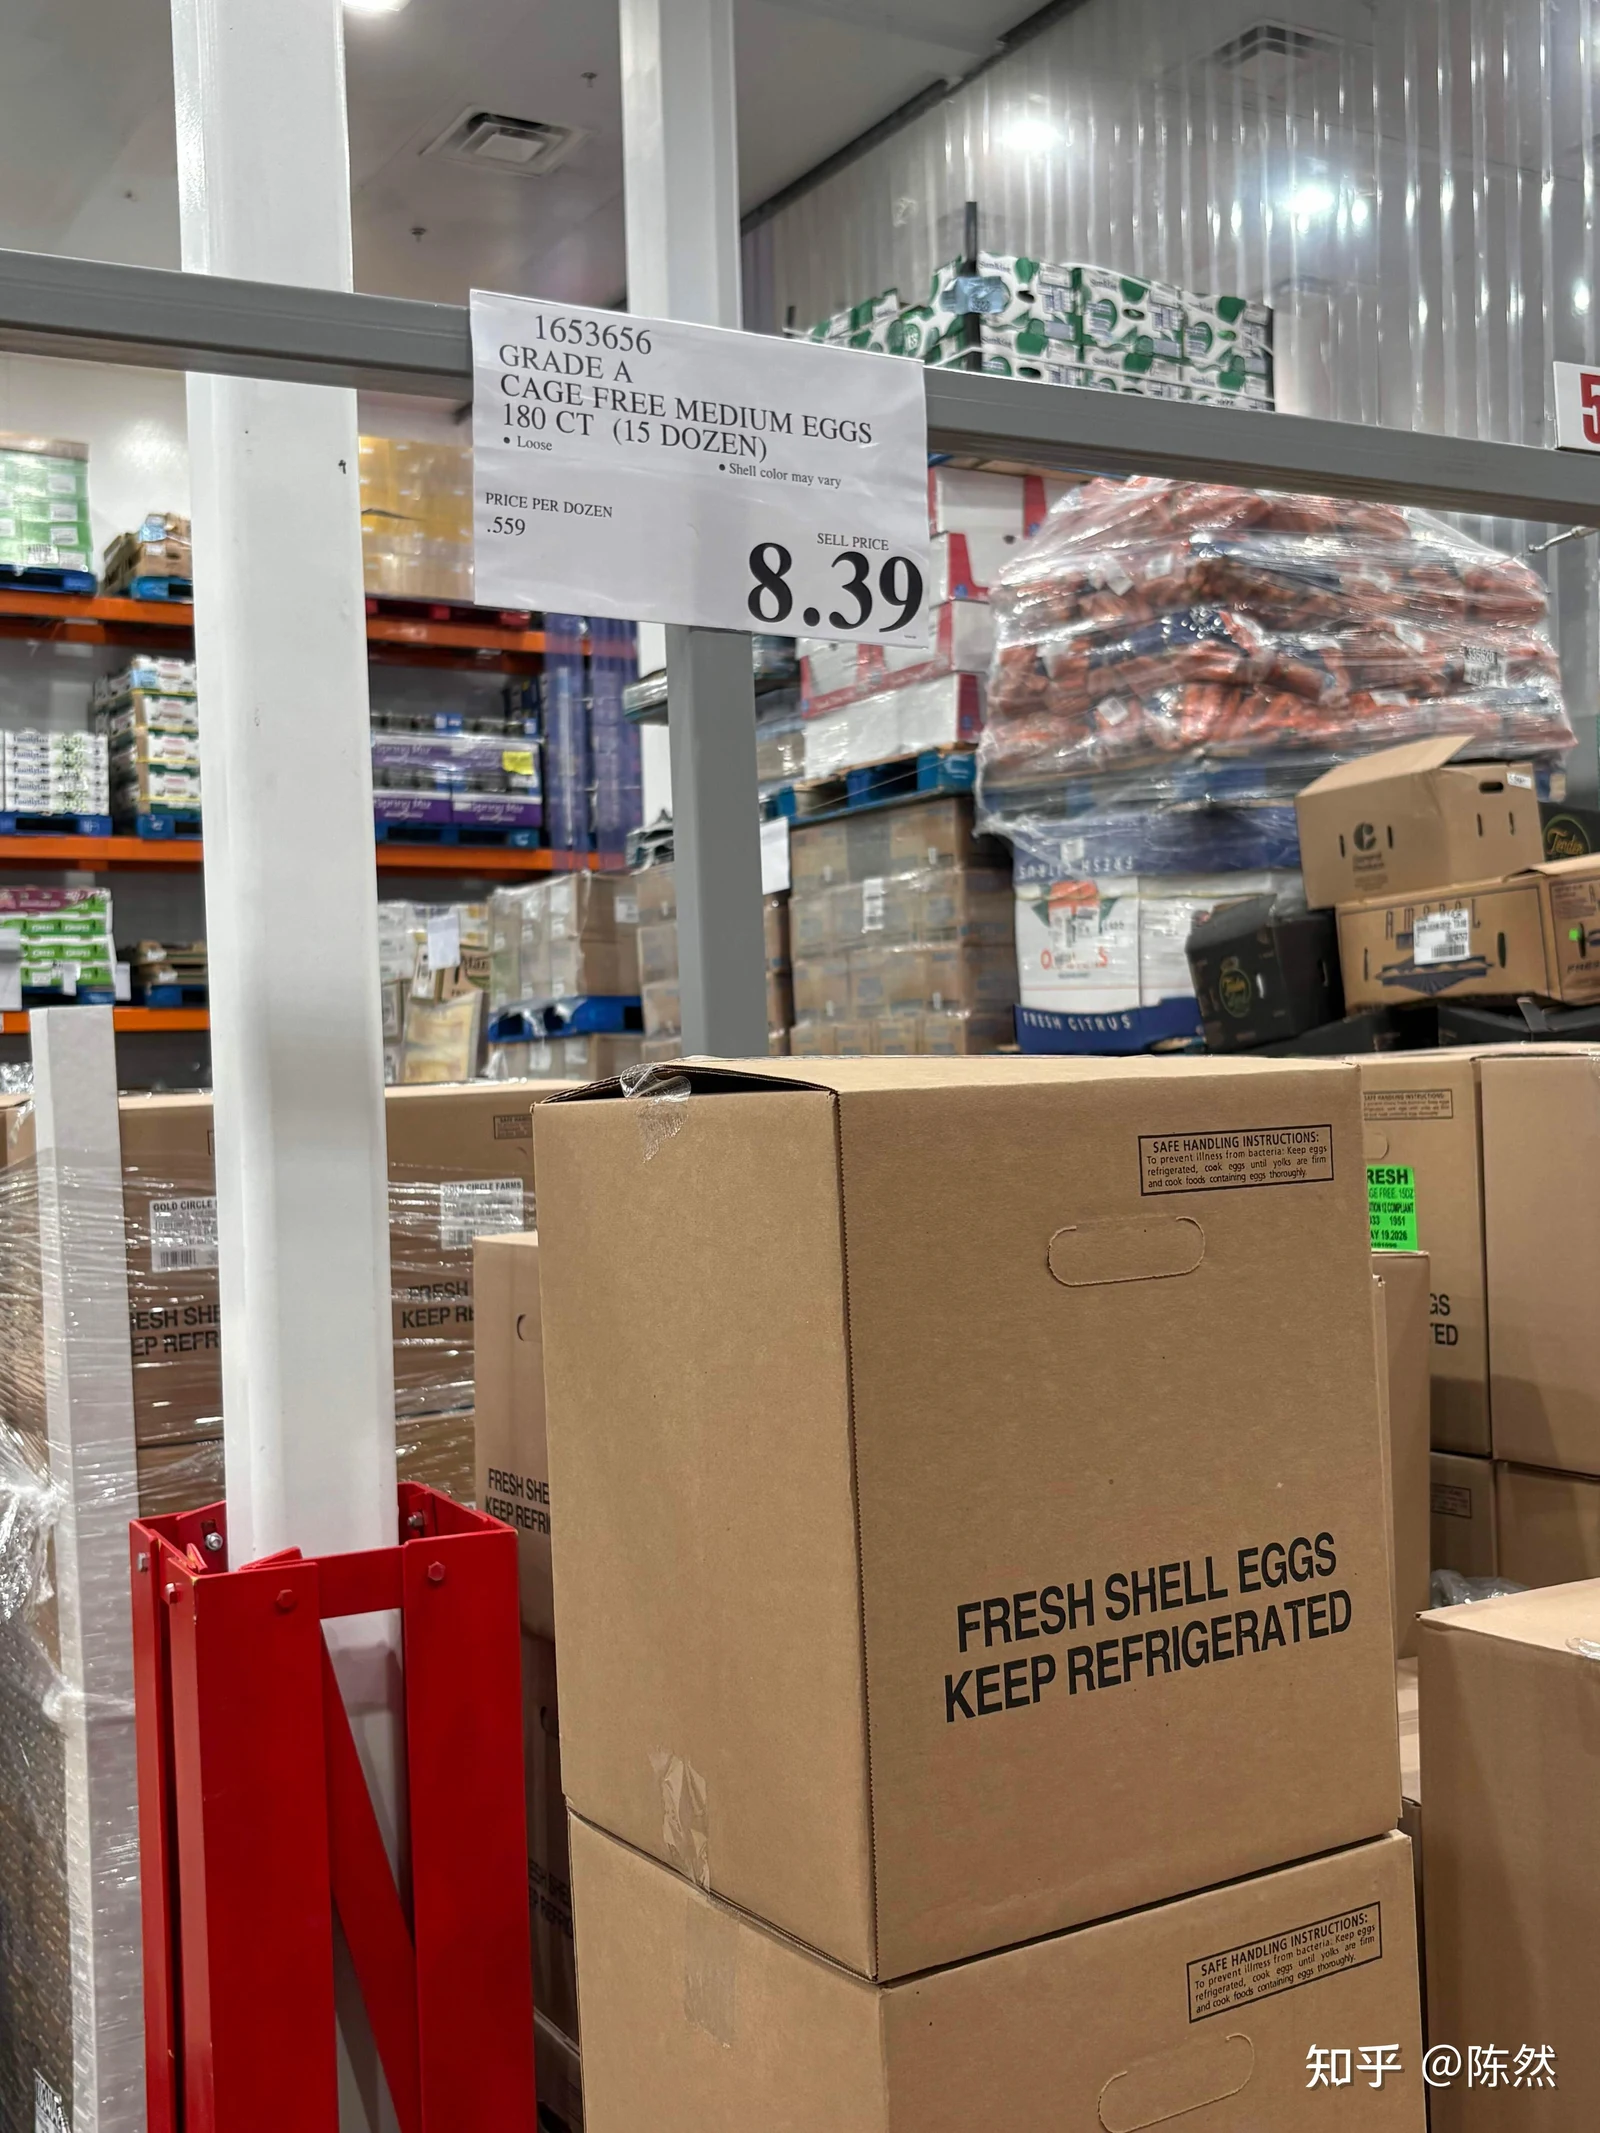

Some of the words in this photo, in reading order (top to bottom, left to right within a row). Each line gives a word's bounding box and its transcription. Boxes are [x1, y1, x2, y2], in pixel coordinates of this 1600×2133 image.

[535, 314, 652, 355] 1653656
[499, 344, 604, 379] GRADE
[613, 360, 633, 383] A
[500, 373, 584, 407] CAGE
[592, 386, 666, 420] FREE
[674, 397, 794, 435] MEDIUM
[801, 414, 873, 444] EGGS
[503, 403, 546, 430] 180
[556, 411, 594, 436] CT
[613, 418, 650, 445] (15
[660, 423, 767, 463] DOZEN)
[517, 436, 553, 451] Loose
[728, 462, 757, 477] Shell
[760, 469, 788, 482] color
[791, 474, 815, 487] may
[817, 475, 842, 490] vary
[485, 492, 528, 509] PRICE
[532, 497, 559, 512] PER
[563, 501, 613, 518] DOZEN
[487, 516, 526, 536] .559
[816, 532, 849, 547] SELL
[852, 536, 889, 551] PRICE
[747, 542, 923, 633] 8.39
[1067, 1014, 1133, 1032] CITRUS
[1147, 1155, 1157, 1165] To
[1160, 1153, 1193, 1166] prevent
[1196, 1151, 1222, 1161] illness
[1226, 1149, 1245, 1159] from
[1248, 1148, 1285, 1158] bacteria:
[1287, 1146, 1306, 1156] Keep
[1309, 1145, 1327, 1155] eggs
[1153, 1140, 1180, 1153] SAFE
[1183, 1136, 1239, 1151] HANDLING
[1243, 1131, 1319, 1147] INSTRUCTIONS:
[1147, 1164, 1199, 1178] refrigerated,
[1204, 1163, 1222, 1173] cook
[1228, 1162, 1245, 1173] eggs
[1250, 1159, 1267, 1169] until
[1273, 1157, 1291, 1169] yolks
[1296, 1158, 1308, 1166] are
[1312, 1155, 1326, 1164] firm
[1148, 1179, 1162, 1188] and
[1164, 1177, 1182, 1187] cook
[1186, 1175, 1206, 1185] foods
[1209, 1172, 1246, 1183] containing
[1250, 1172, 1266, 1182] eggs
[180, 1199, 212, 1211] CIRCLE
[402, 1307, 451, 1329] KEEP
[488, 1467, 524, 1498] FRESH
[957, 1578, 1095, 1652] FRESH
[1105, 1555, 1228, 1621] SHELL
[1237, 1531, 1337, 1594] EGGS
[944, 1654, 1056, 1723] KEEP
[1067, 1589, 1352, 1695] REFRIGERATED
[1195, 1980, 1205, 1990] To
[1208, 1968, 1242, 1987] prevent
[1244, 1960, 1271, 1974] illness
[1274, 1951, 1293, 1964] from
[1335, 1931, 1355, 1944] Keep
[1357, 1924, 1376, 1937] eggs
[1201, 1957, 1228, 1977] SAFE
[1231, 1938, 1288, 1967] HANDLING
[1291, 1913, 1368, 1947] INSTRUCTIONS:
[1195, 1977, 1247, 2002] refrigerated,
[1252, 1969, 1270, 1983] cook
[1276, 1963, 1293, 1976] eggs
[1298, 1953, 1315, 1967] until
[1321, 1947, 1339, 1961] yolks
[1345, 1942, 1356, 1952] are
[1360, 1935, 1375, 1946] firm
[1196, 2001, 1210, 2014] and
[1213, 1995, 1231, 2008] cook
[1234, 1987, 1254, 2000] foods
[1257, 1974, 1294, 1993] containing
[1298, 1967, 1314, 1980] eggs
[1317, 1953, 1356, 1973] thoroughly.
